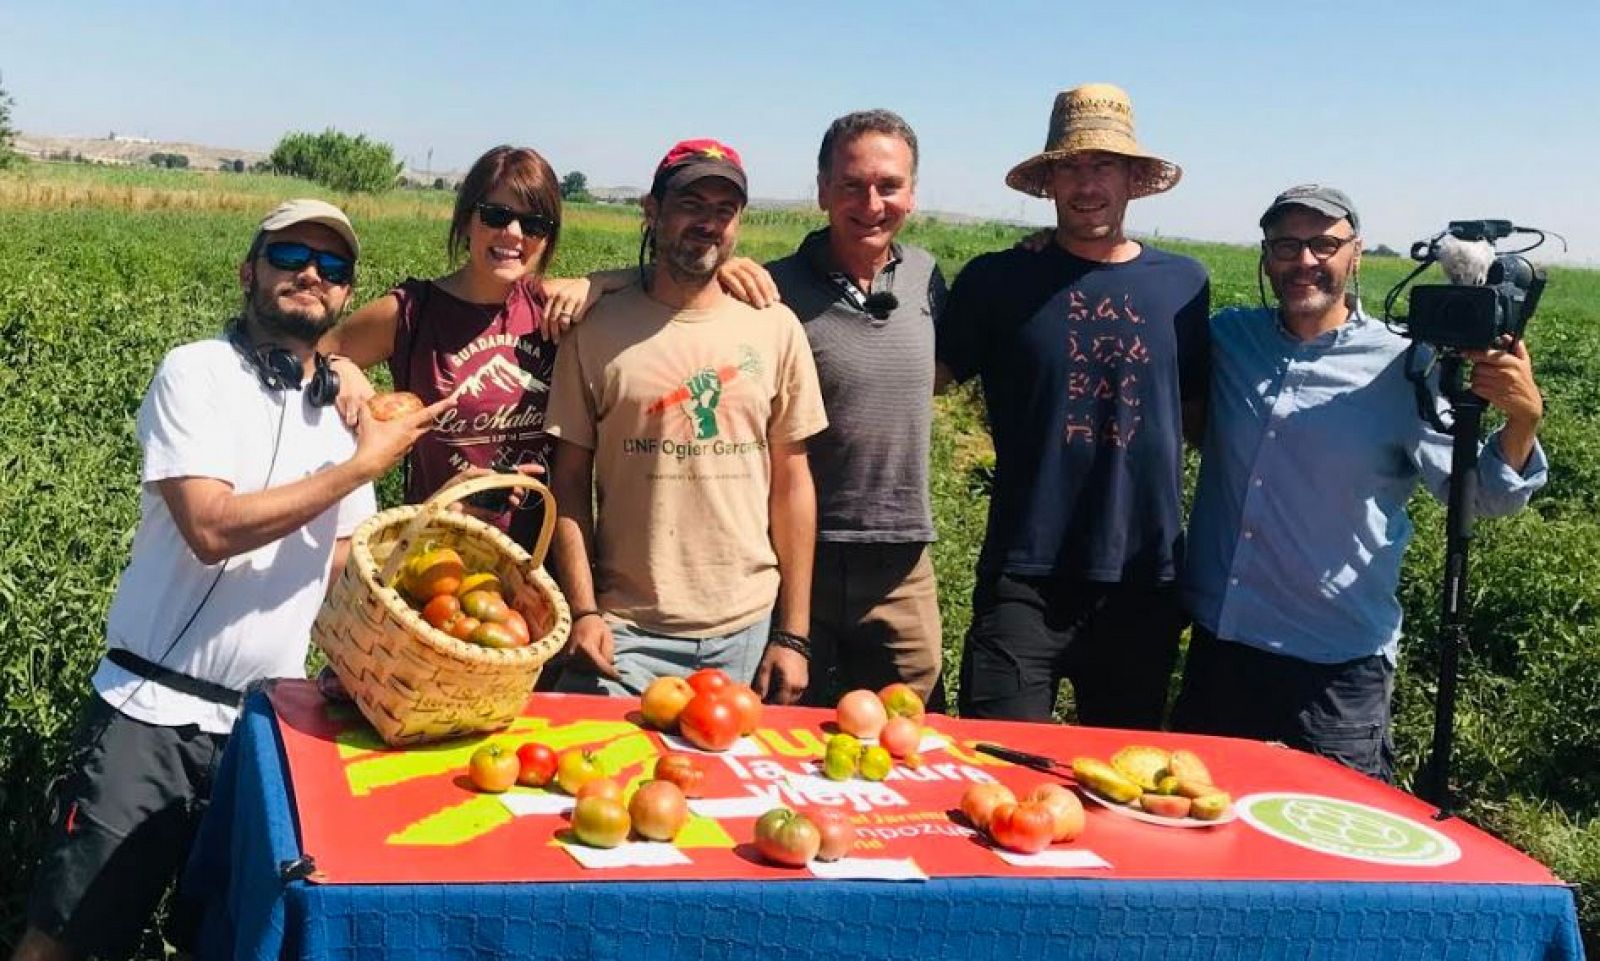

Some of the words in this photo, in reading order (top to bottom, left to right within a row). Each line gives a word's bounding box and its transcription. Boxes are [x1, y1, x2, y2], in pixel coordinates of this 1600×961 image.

[451, 333, 541, 368] GUADARRAMA
[433, 407, 467, 433] La
[473, 402, 544, 431] Malic
[662, 439, 708, 459] Ogier
